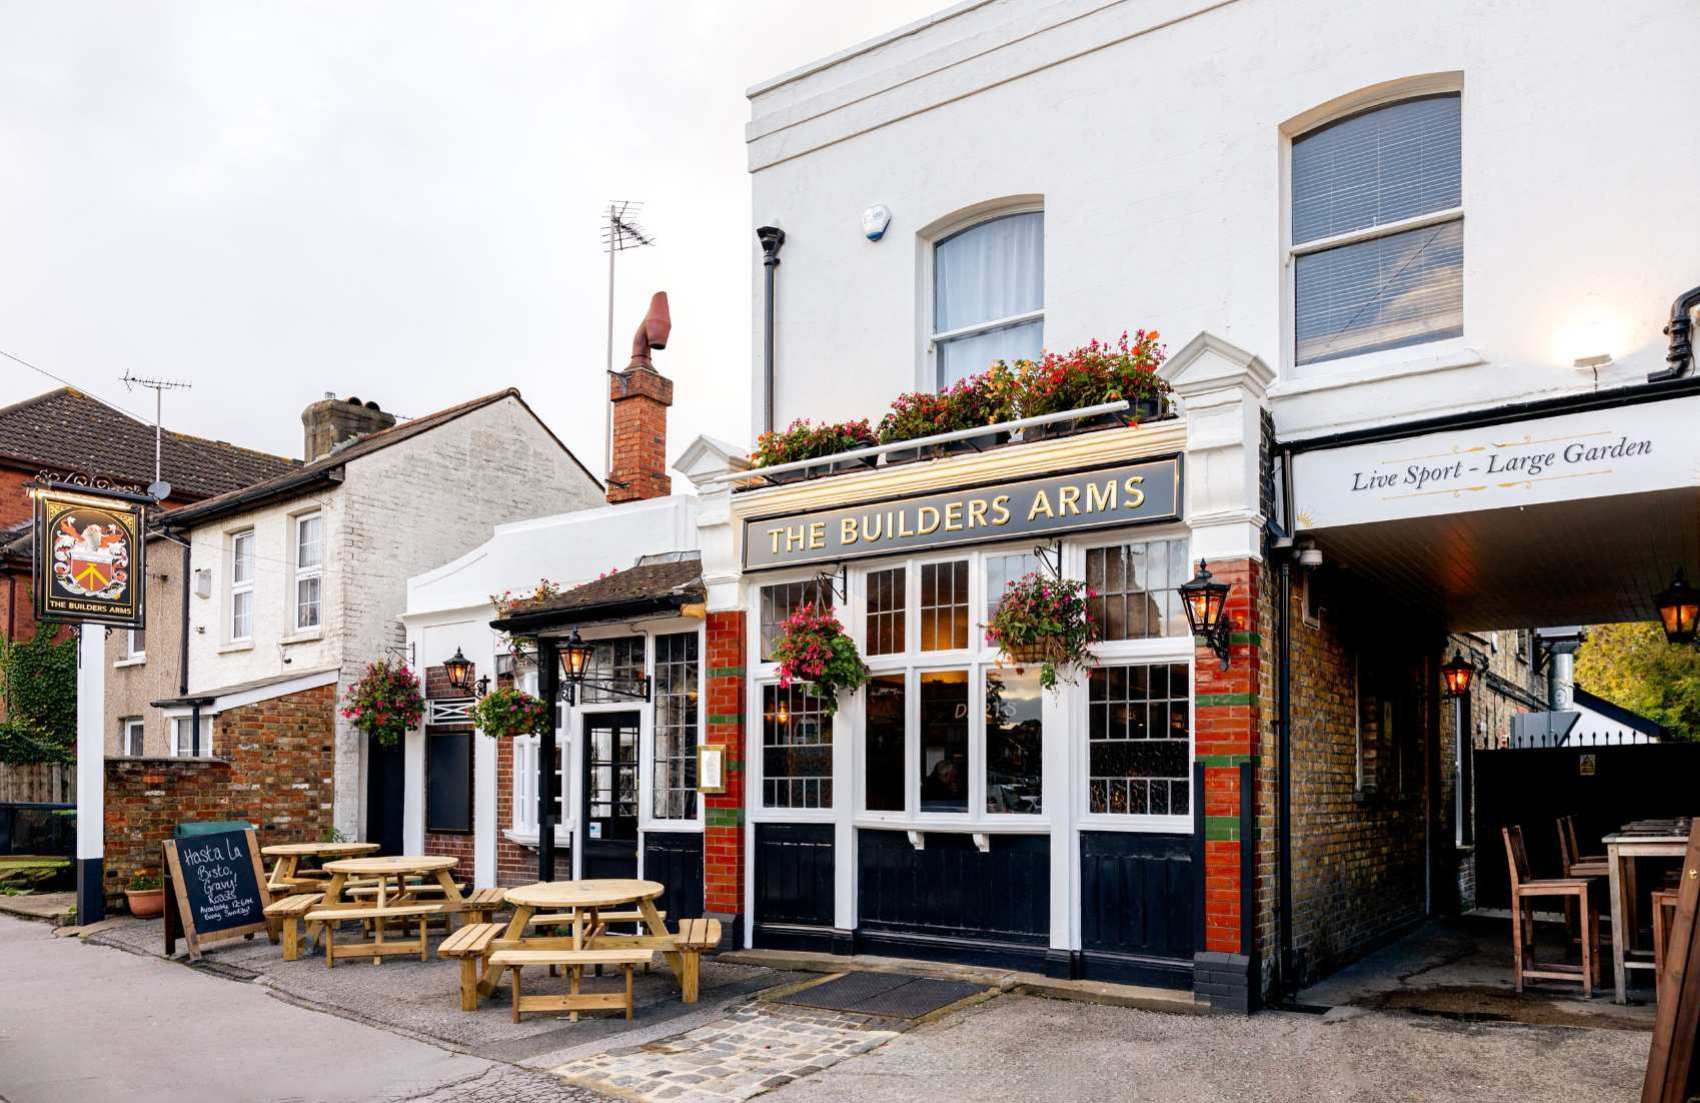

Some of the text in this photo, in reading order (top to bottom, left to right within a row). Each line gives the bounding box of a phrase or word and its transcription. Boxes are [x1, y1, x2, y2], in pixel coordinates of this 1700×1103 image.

[1351, 472, 1397, 492] Live
[1403, 459, 1463, 488] Sport
[1487, 451, 1556, 476] Large
[1563, 436, 1653, 464] Garden
[767, 475, 1146, 555] THE BUILDERS ARMS
[50, 600, 132, 615] THE BUILDERS ARMS
[184, 845, 225, 866] Hasta
[203, 872, 238, 896] Gravy!
